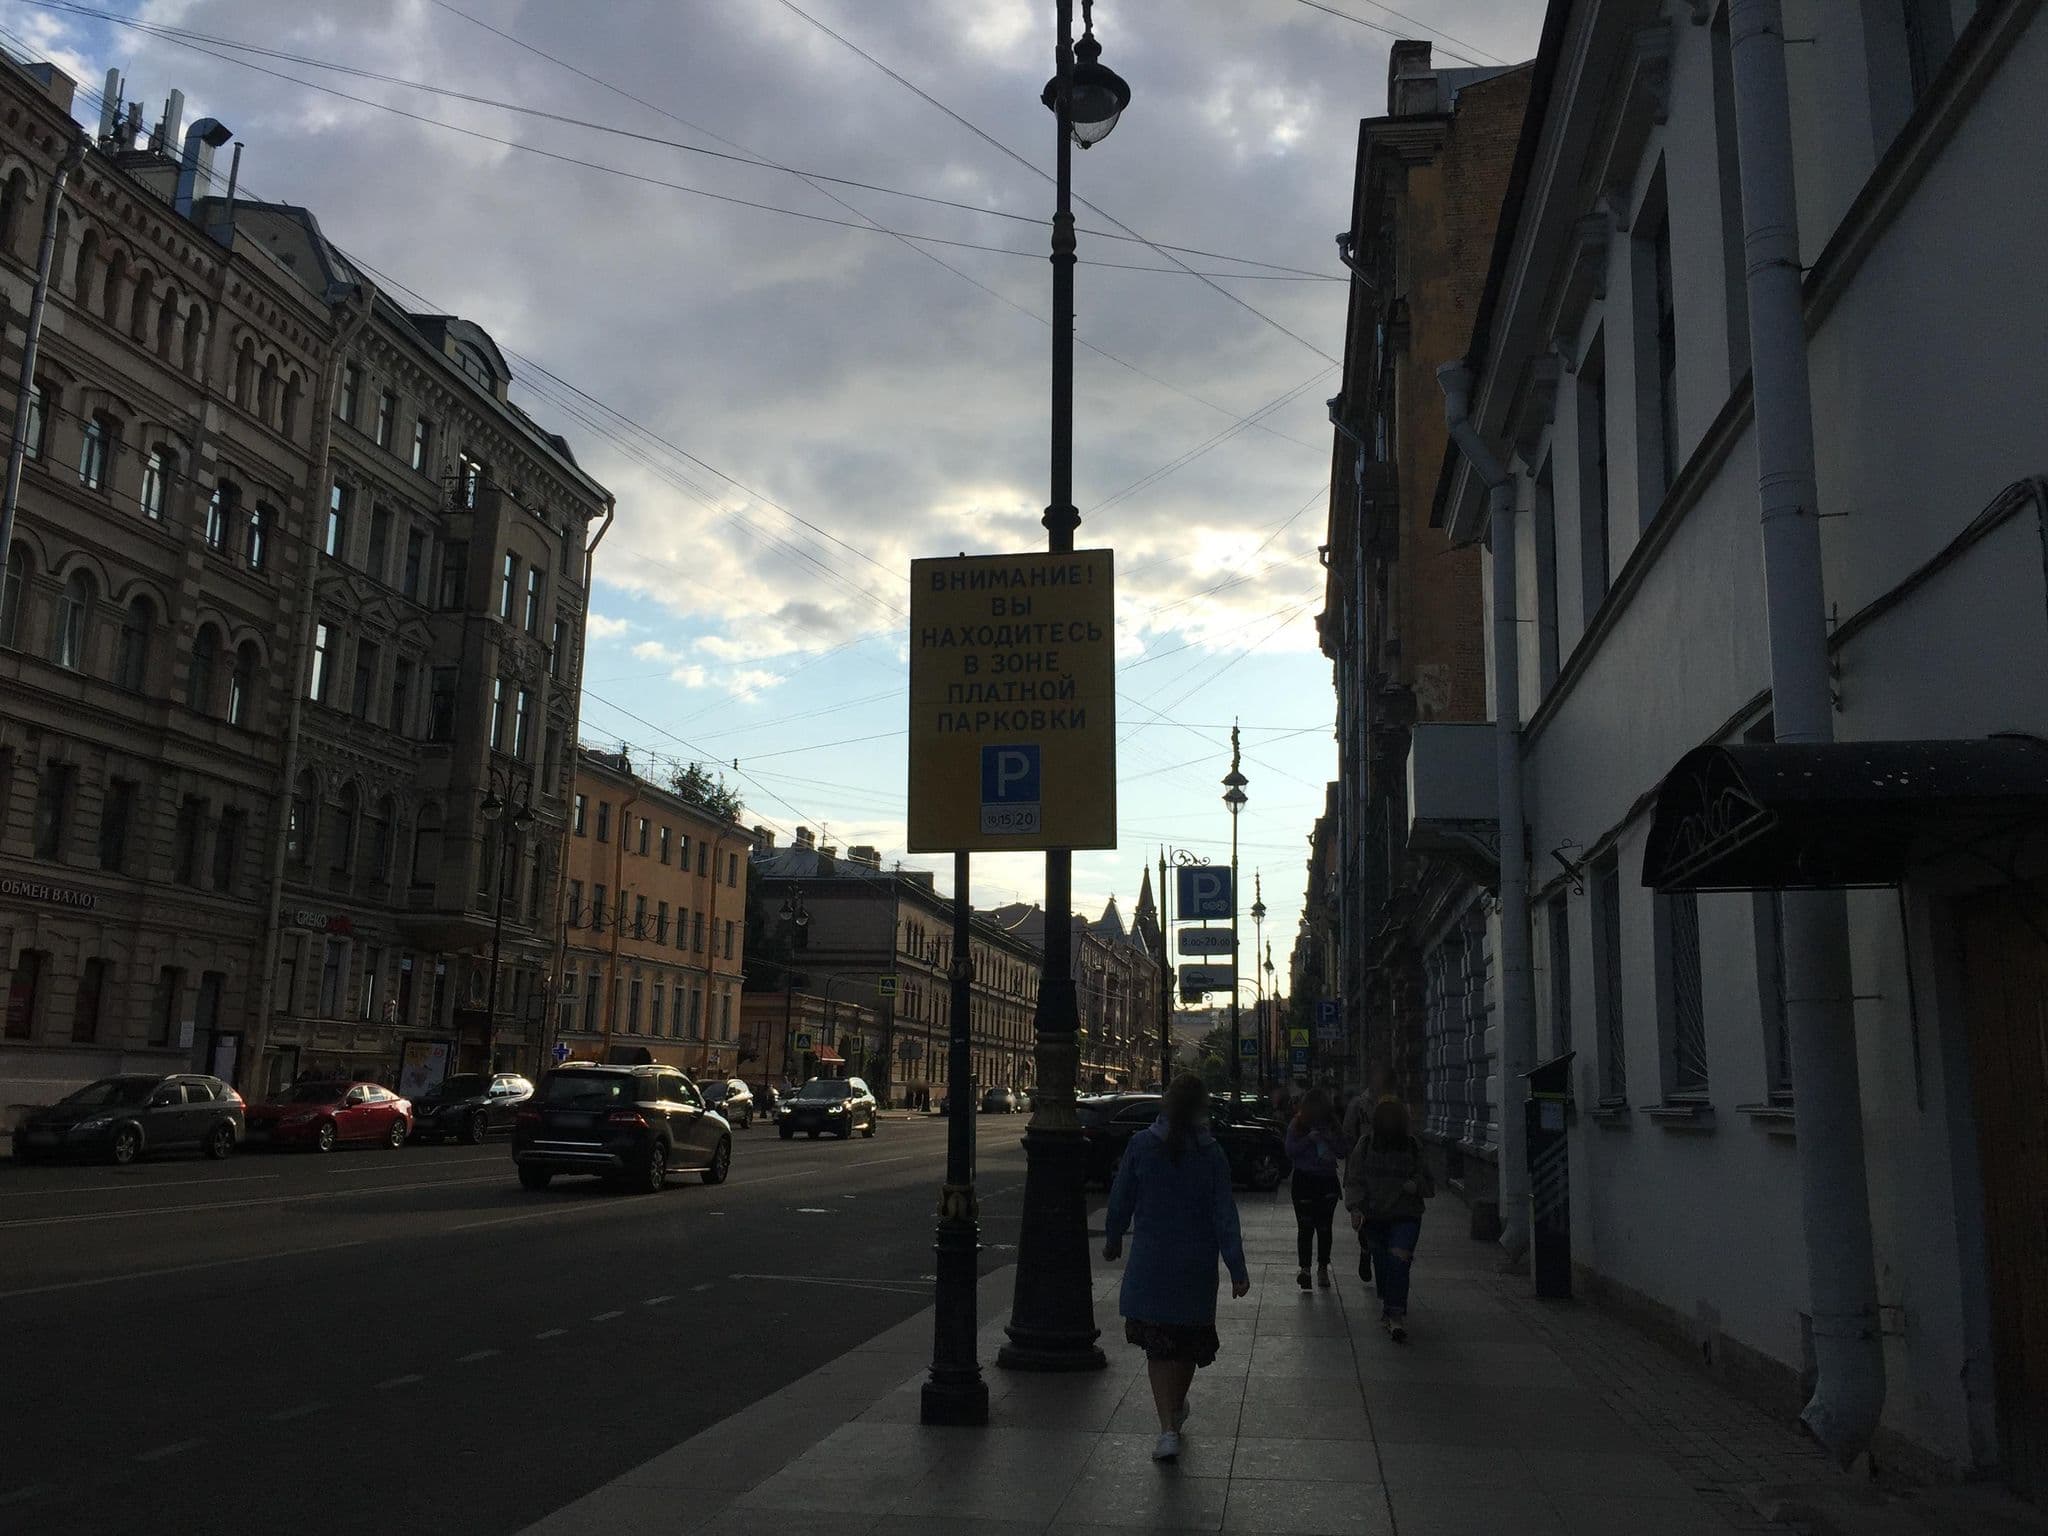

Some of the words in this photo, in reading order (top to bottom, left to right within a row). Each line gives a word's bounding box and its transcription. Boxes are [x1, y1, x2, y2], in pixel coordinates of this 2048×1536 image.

[931, 564, 1093, 592] ВНИМАНИЕ!
[991, 596, 1032, 617] ВЫ
[921, 621, 1102, 648] НАХОДИТЕСЬ
[964, 654, 979, 675] В
[991, 651, 1060, 675] ЗОНЕ
[947, 673, 1076, 705] ПЛАТНОЙ
[937, 707, 1086, 733] ПАРКОВКИ
[998, 751, 1031, 797] P
[1000, 814, 1012, 825] 15
[1015, 812, 1033, 825] 20
[1, 879, 49, 900] ОБМЕН
[1192, 871, 1221, 913] P
